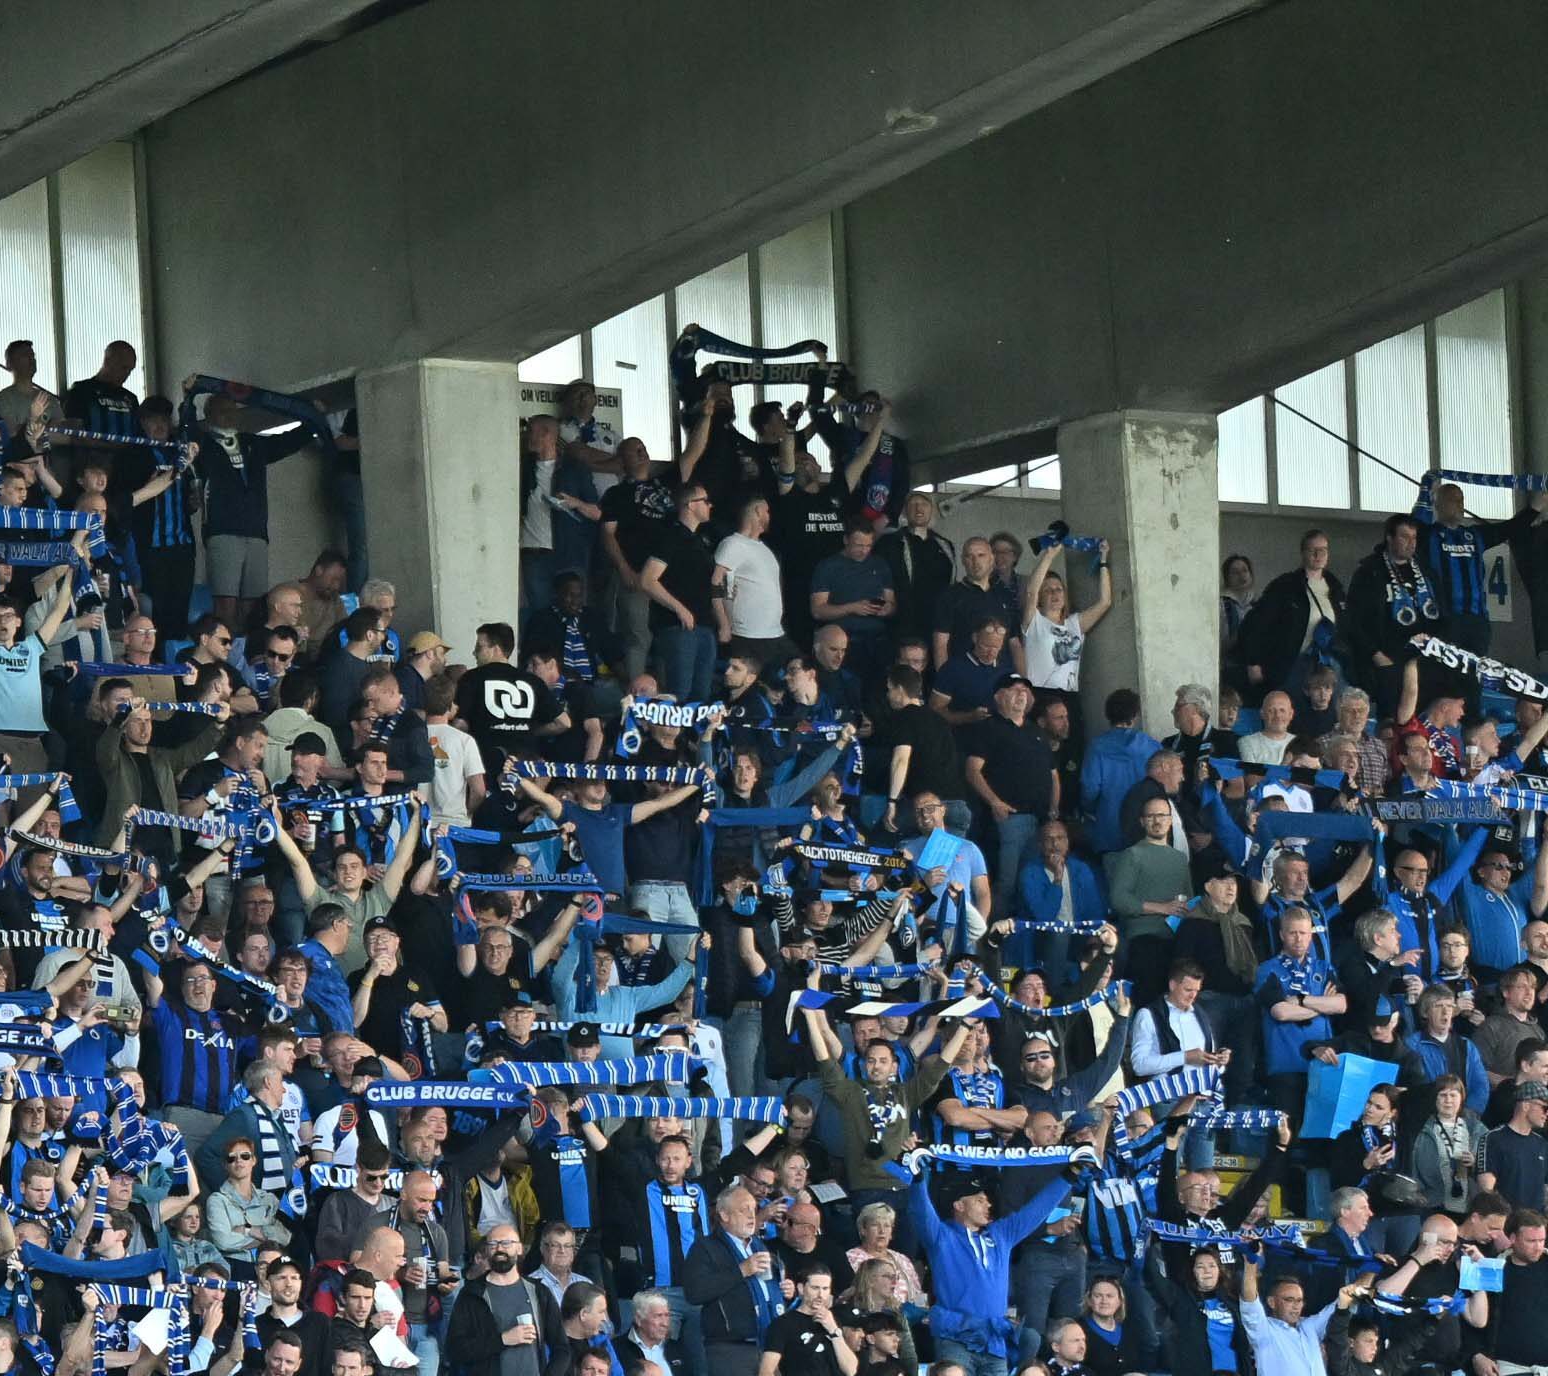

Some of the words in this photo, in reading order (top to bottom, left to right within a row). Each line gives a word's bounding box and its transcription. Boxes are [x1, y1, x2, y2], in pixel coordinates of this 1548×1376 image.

[367, 1083, 416, 1102] CLUB
[420, 1083, 495, 1101] BRUGGE
[954, 1144, 1000, 1159] SWEAT
[1004, 1145, 1024, 1159] NO
